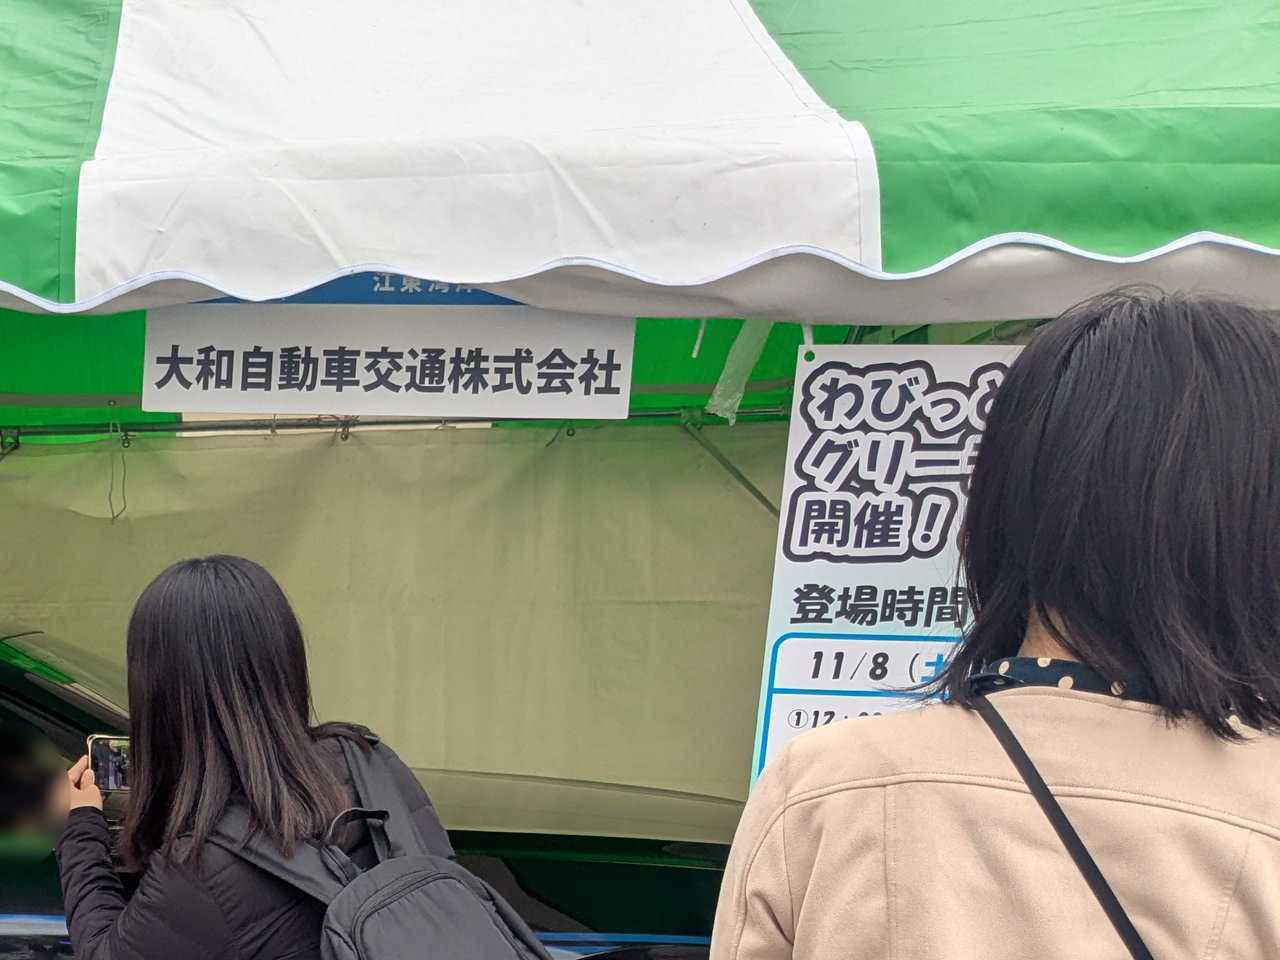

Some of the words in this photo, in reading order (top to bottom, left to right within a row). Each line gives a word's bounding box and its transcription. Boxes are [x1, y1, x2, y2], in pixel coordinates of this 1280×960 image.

[155, 344, 622, 396] 大和自動車交通株式会社
[811, 438, 979, 486] グリー
[798, 499, 942, 551] 開催!
[790, 583, 966, 628] 登場時間
